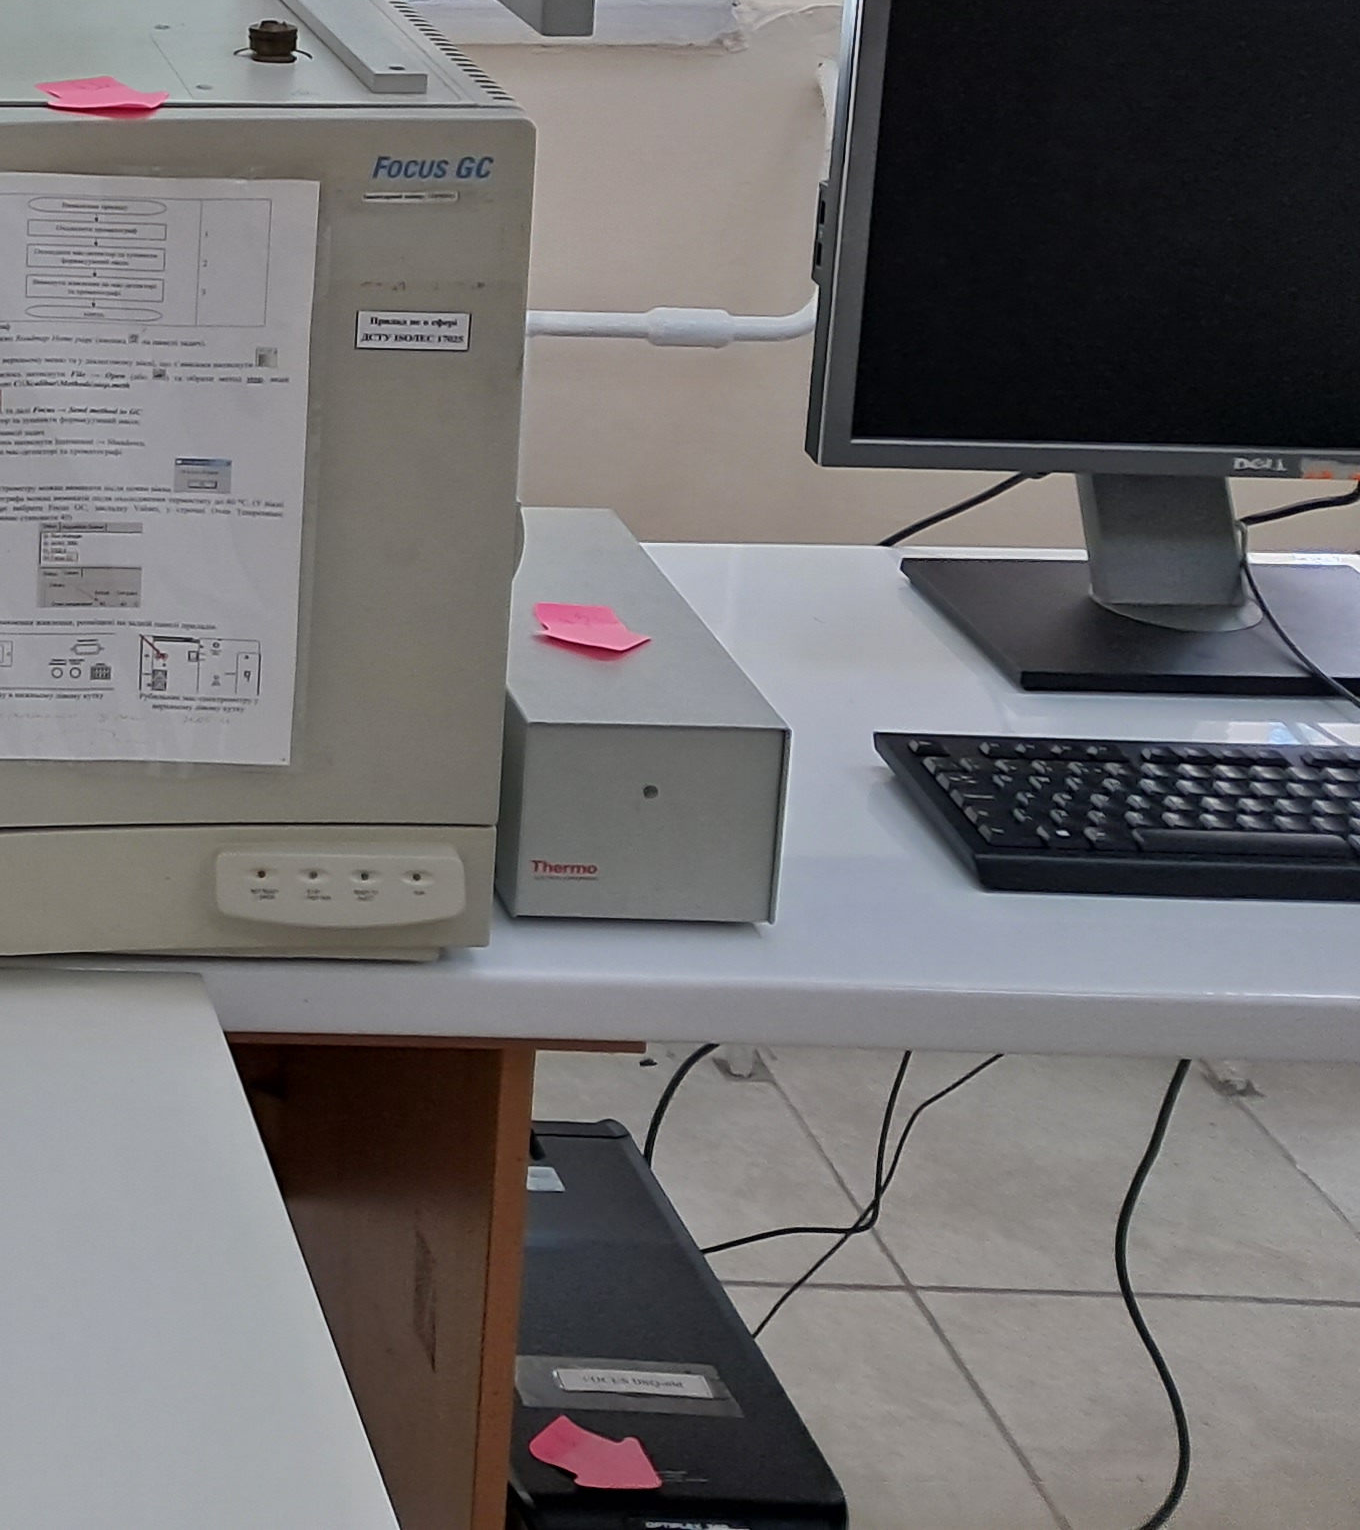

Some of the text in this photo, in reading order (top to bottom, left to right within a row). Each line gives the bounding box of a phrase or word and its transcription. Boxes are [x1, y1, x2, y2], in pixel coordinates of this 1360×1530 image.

[455, 156, 494, 179] GC
[361, 333, 392, 343] ДСТУ
[531, 860, 598, 874] Thermo
